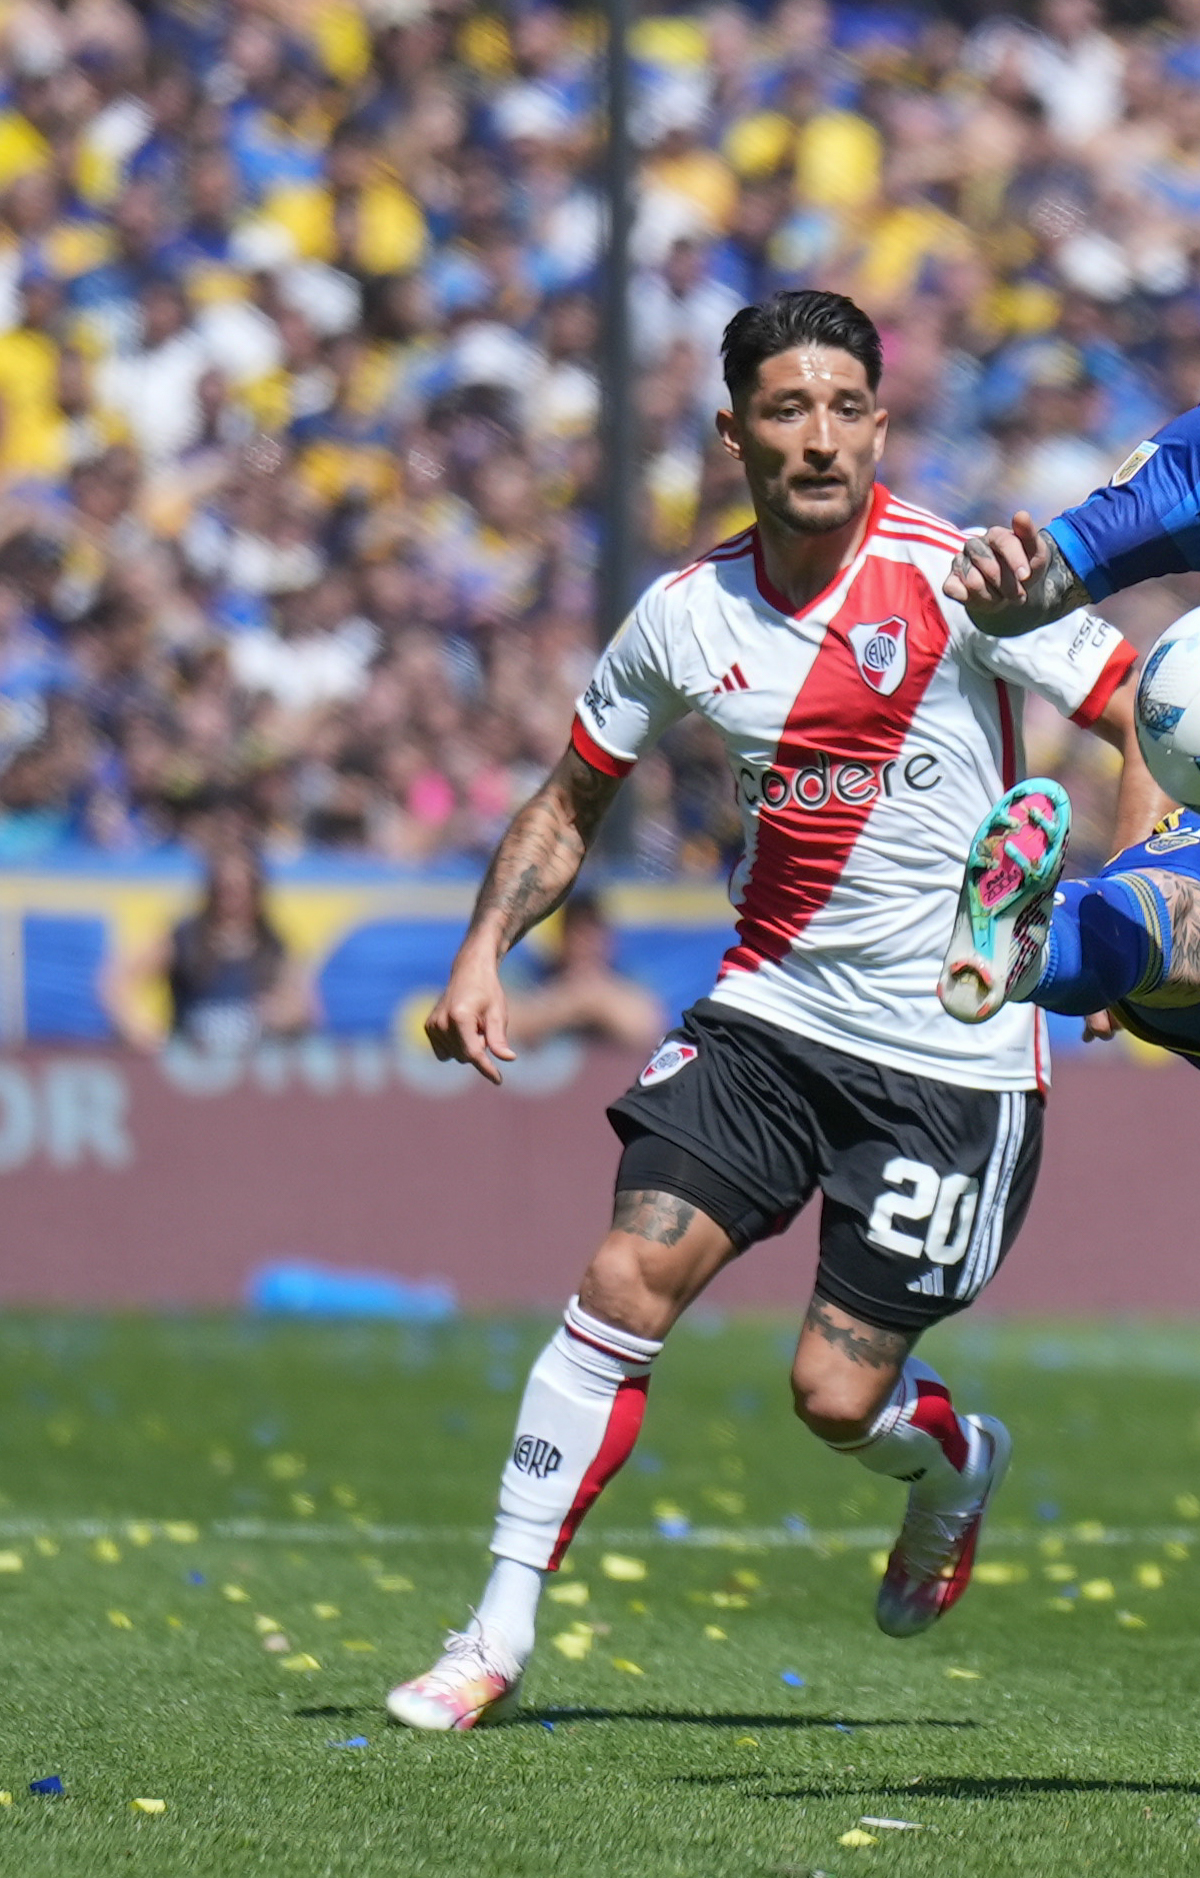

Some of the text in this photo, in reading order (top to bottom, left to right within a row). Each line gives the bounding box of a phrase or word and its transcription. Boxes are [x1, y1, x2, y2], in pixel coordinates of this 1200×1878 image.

[864, 635, 897, 669] CARP
[1067, 616, 1096, 662] ASSI
[1091, 622, 1111, 648] CA
[739, 750, 944, 808] codere
[866, 1156, 981, 1266] 20
[513, 1434, 563, 1479] CARP
